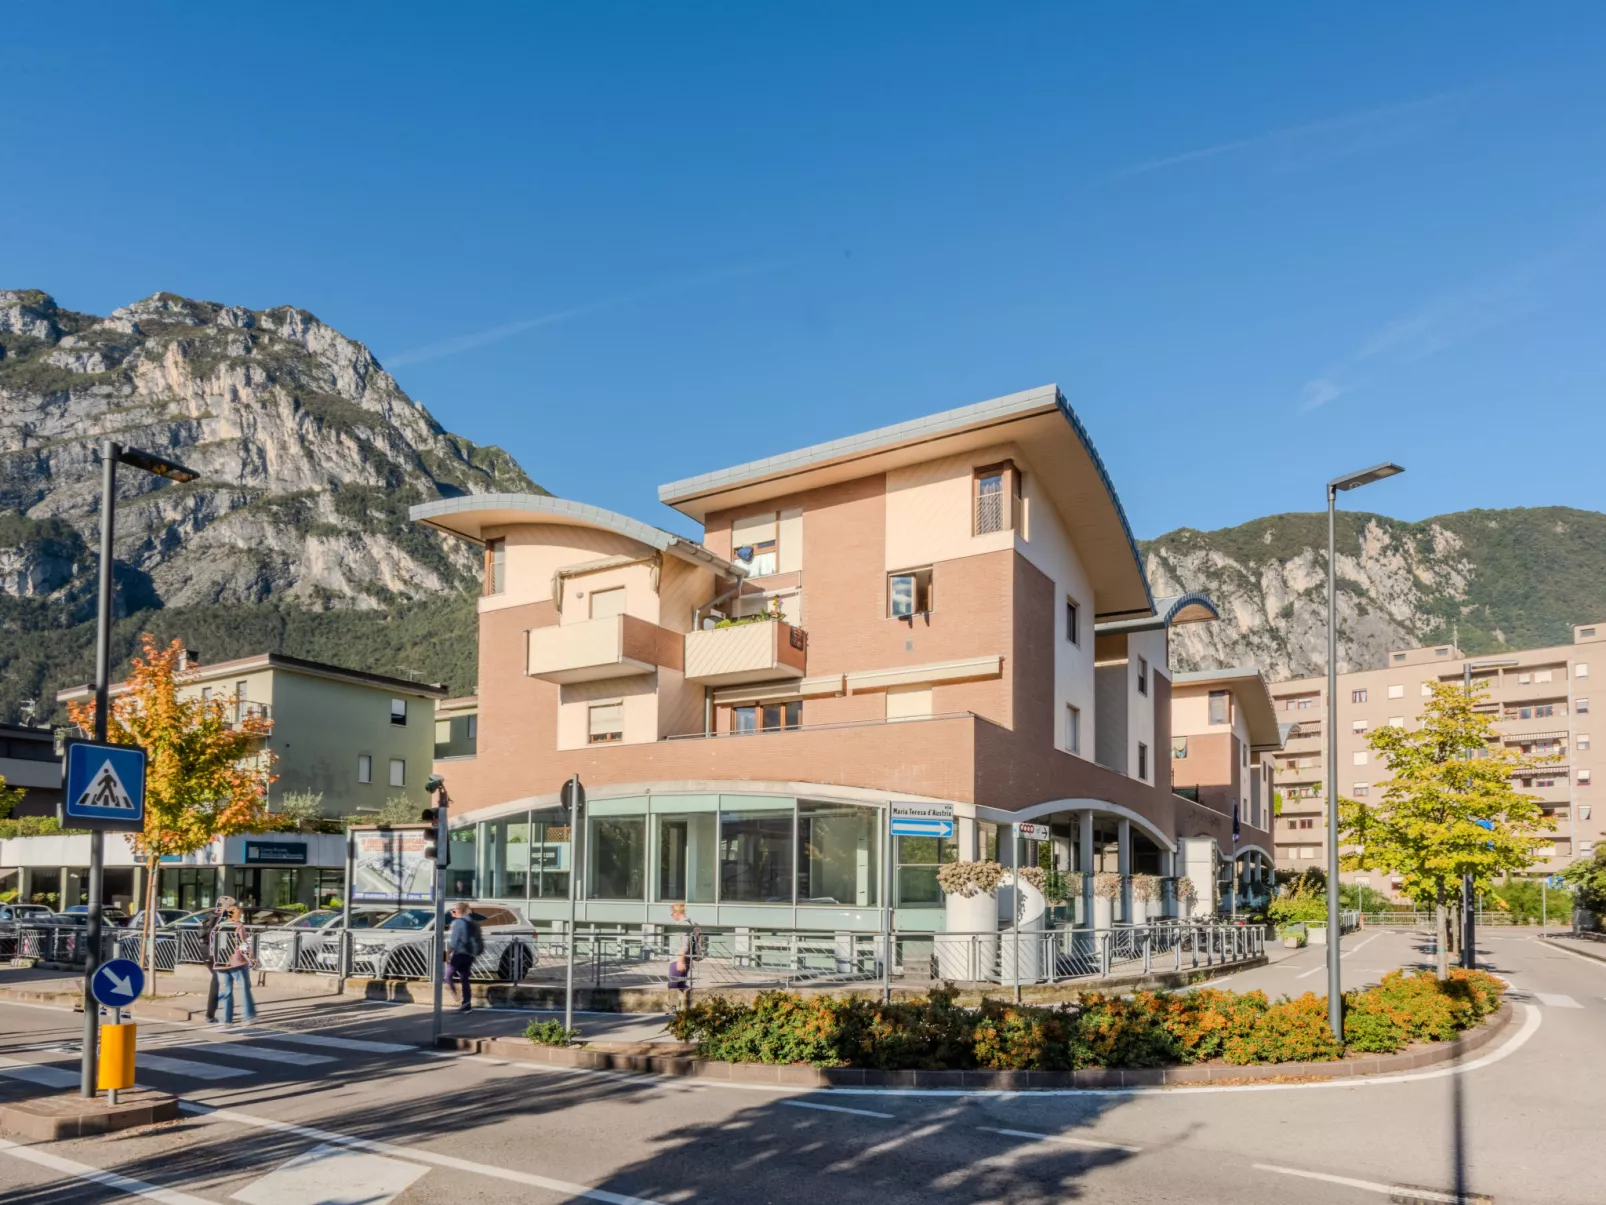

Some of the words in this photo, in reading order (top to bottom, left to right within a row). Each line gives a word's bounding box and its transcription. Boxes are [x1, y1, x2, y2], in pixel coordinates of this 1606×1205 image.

[893, 807, 908, 815] Maria
[909, 808, 926, 816] Teresa
[927, 808, 952, 817] d'Austria
